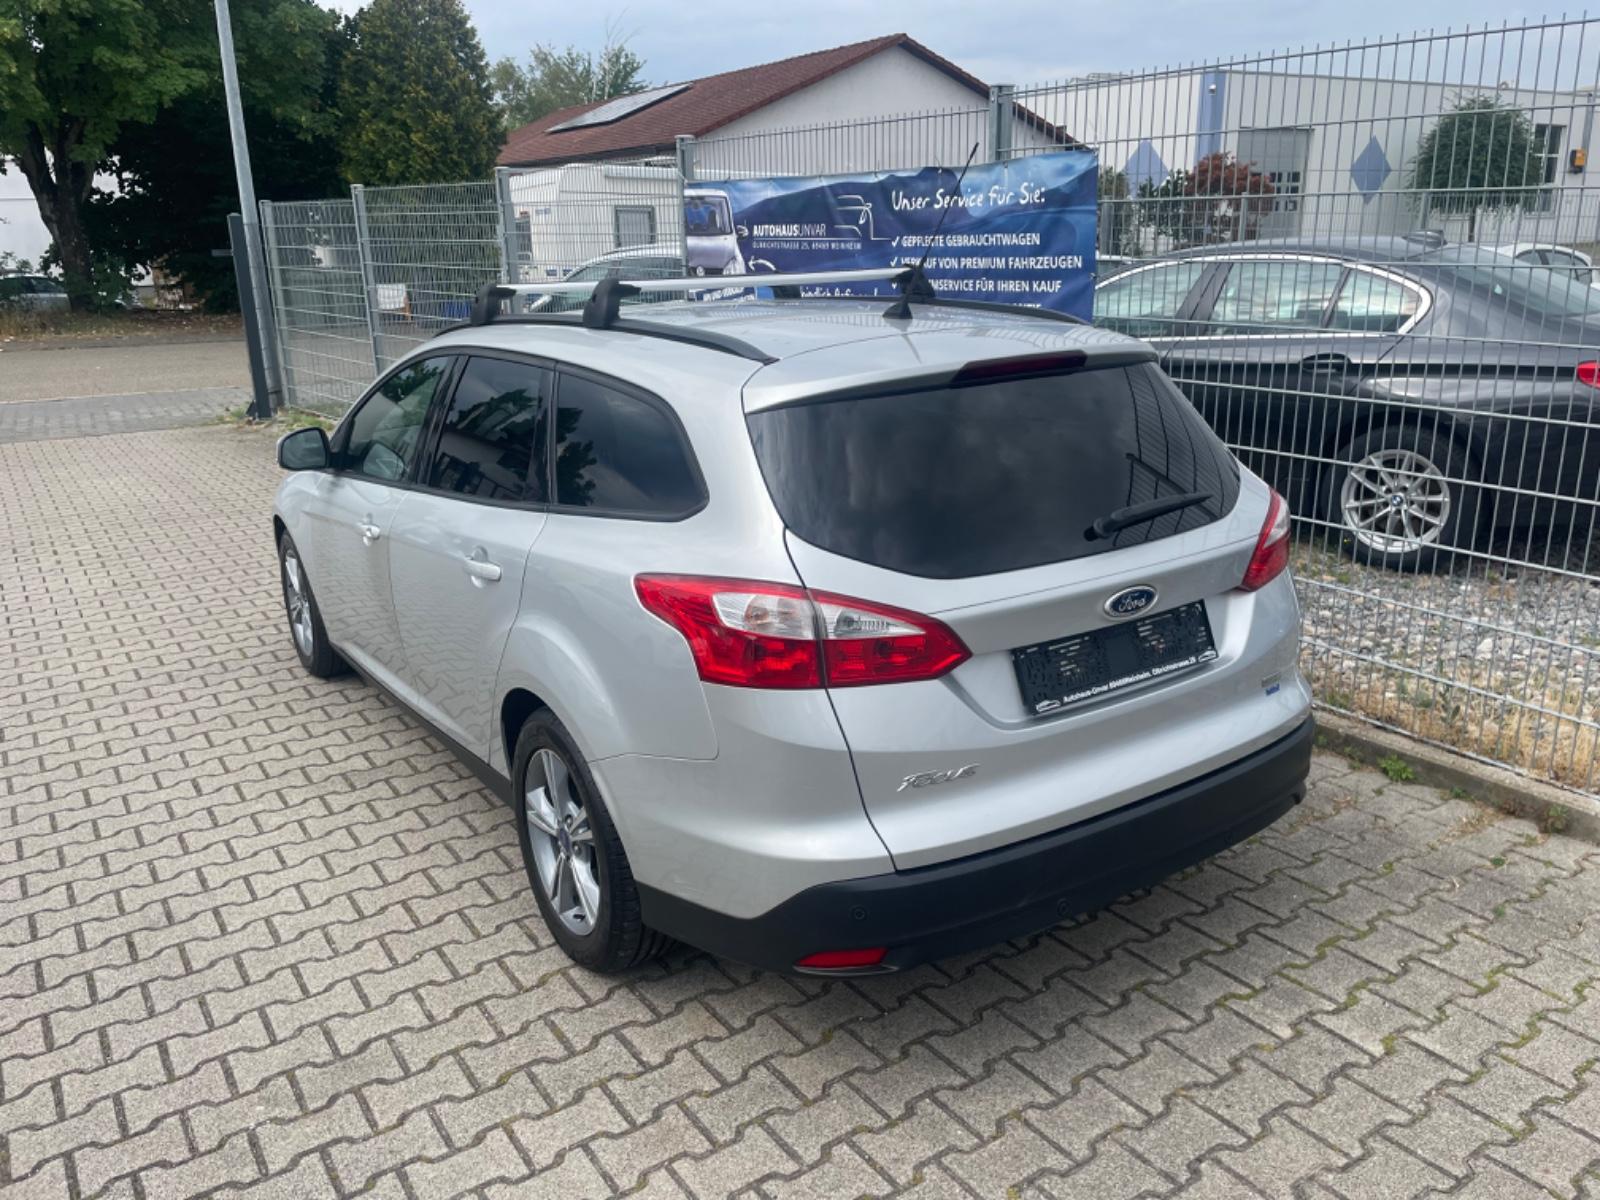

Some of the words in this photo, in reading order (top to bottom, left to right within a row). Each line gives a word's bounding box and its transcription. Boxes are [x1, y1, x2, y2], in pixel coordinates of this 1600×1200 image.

[892, 190, 930, 210] Unser
[933, 188, 984, 209] Service
[1019, 182, 1046, 204] Sie:
[946, 233, 1041, 247] GEBRAUCHTWAGEN
[938, 256, 959, 270] VON
[960, 257, 1006, 270] PREMIUM
[1008, 255, 1082, 270] FAHRZEUGEN
[976, 277, 995, 292] FÜR
[997, 280, 1029, 293] IHREN
[1032, 280, 1062, 293] KAUF
